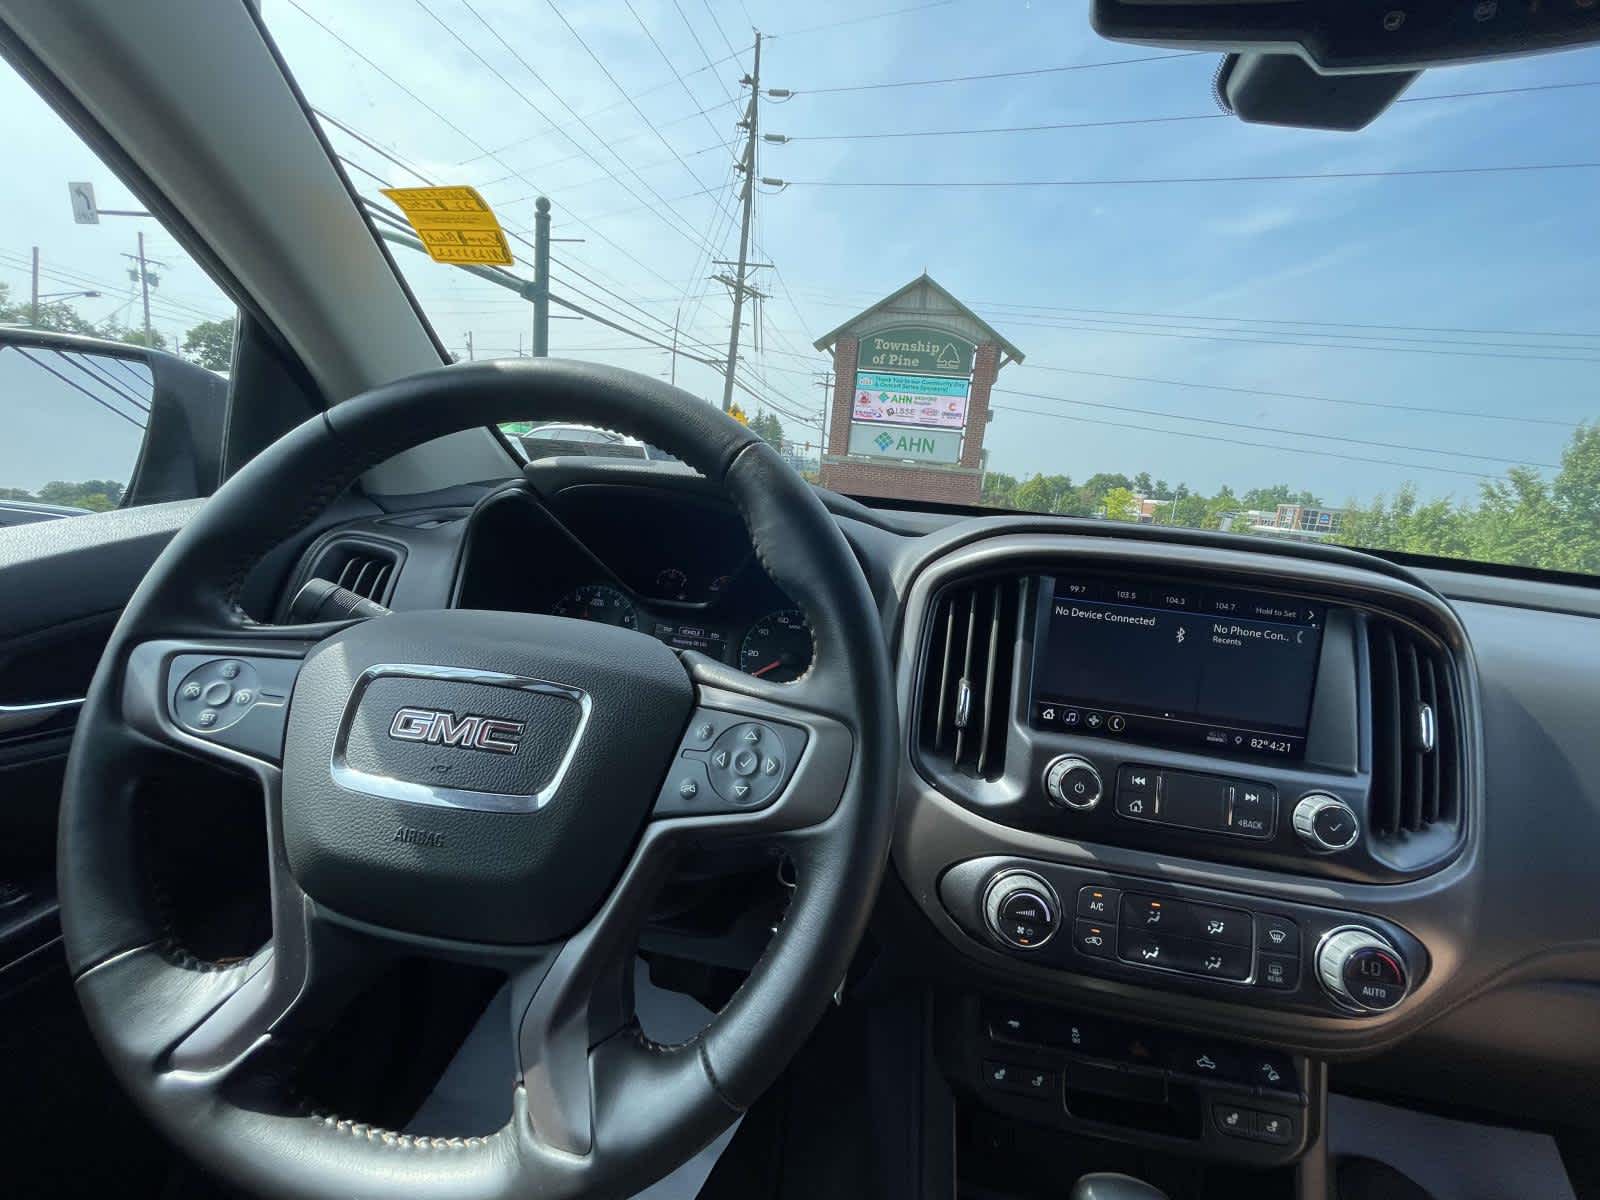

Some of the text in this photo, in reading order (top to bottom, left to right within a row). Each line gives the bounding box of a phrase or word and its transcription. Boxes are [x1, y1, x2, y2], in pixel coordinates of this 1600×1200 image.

[874, 338, 939, 356] Township
[872, 353, 920, 367] of Pine
[890, 394, 913, 404] AHN
[896, 437, 936, 454] AHN
[1069, 585, 1237, 611] 99.7 103.5 104.3 104.7
[1055, 606, 1156, 627] No Device Connected
[1255, 607, 1273, 616] Hold
[1283, 610, 1297, 618] Set
[1213, 623, 1229, 634] No
[1230, 625, 1262, 639] Phone
[1212, 635, 1242, 646] Recents
[747, 649, 760, 658] 20
[390, 706, 526, 757] GMC
[1269, 741, 1291, 753] 4:21
[1242, 819, 1263, 830] BACK
[395, 827, 446, 848] AIRBAG
[1089, 901, 1105, 912] A/C
[1362, 985, 1387, 998] AUTO
